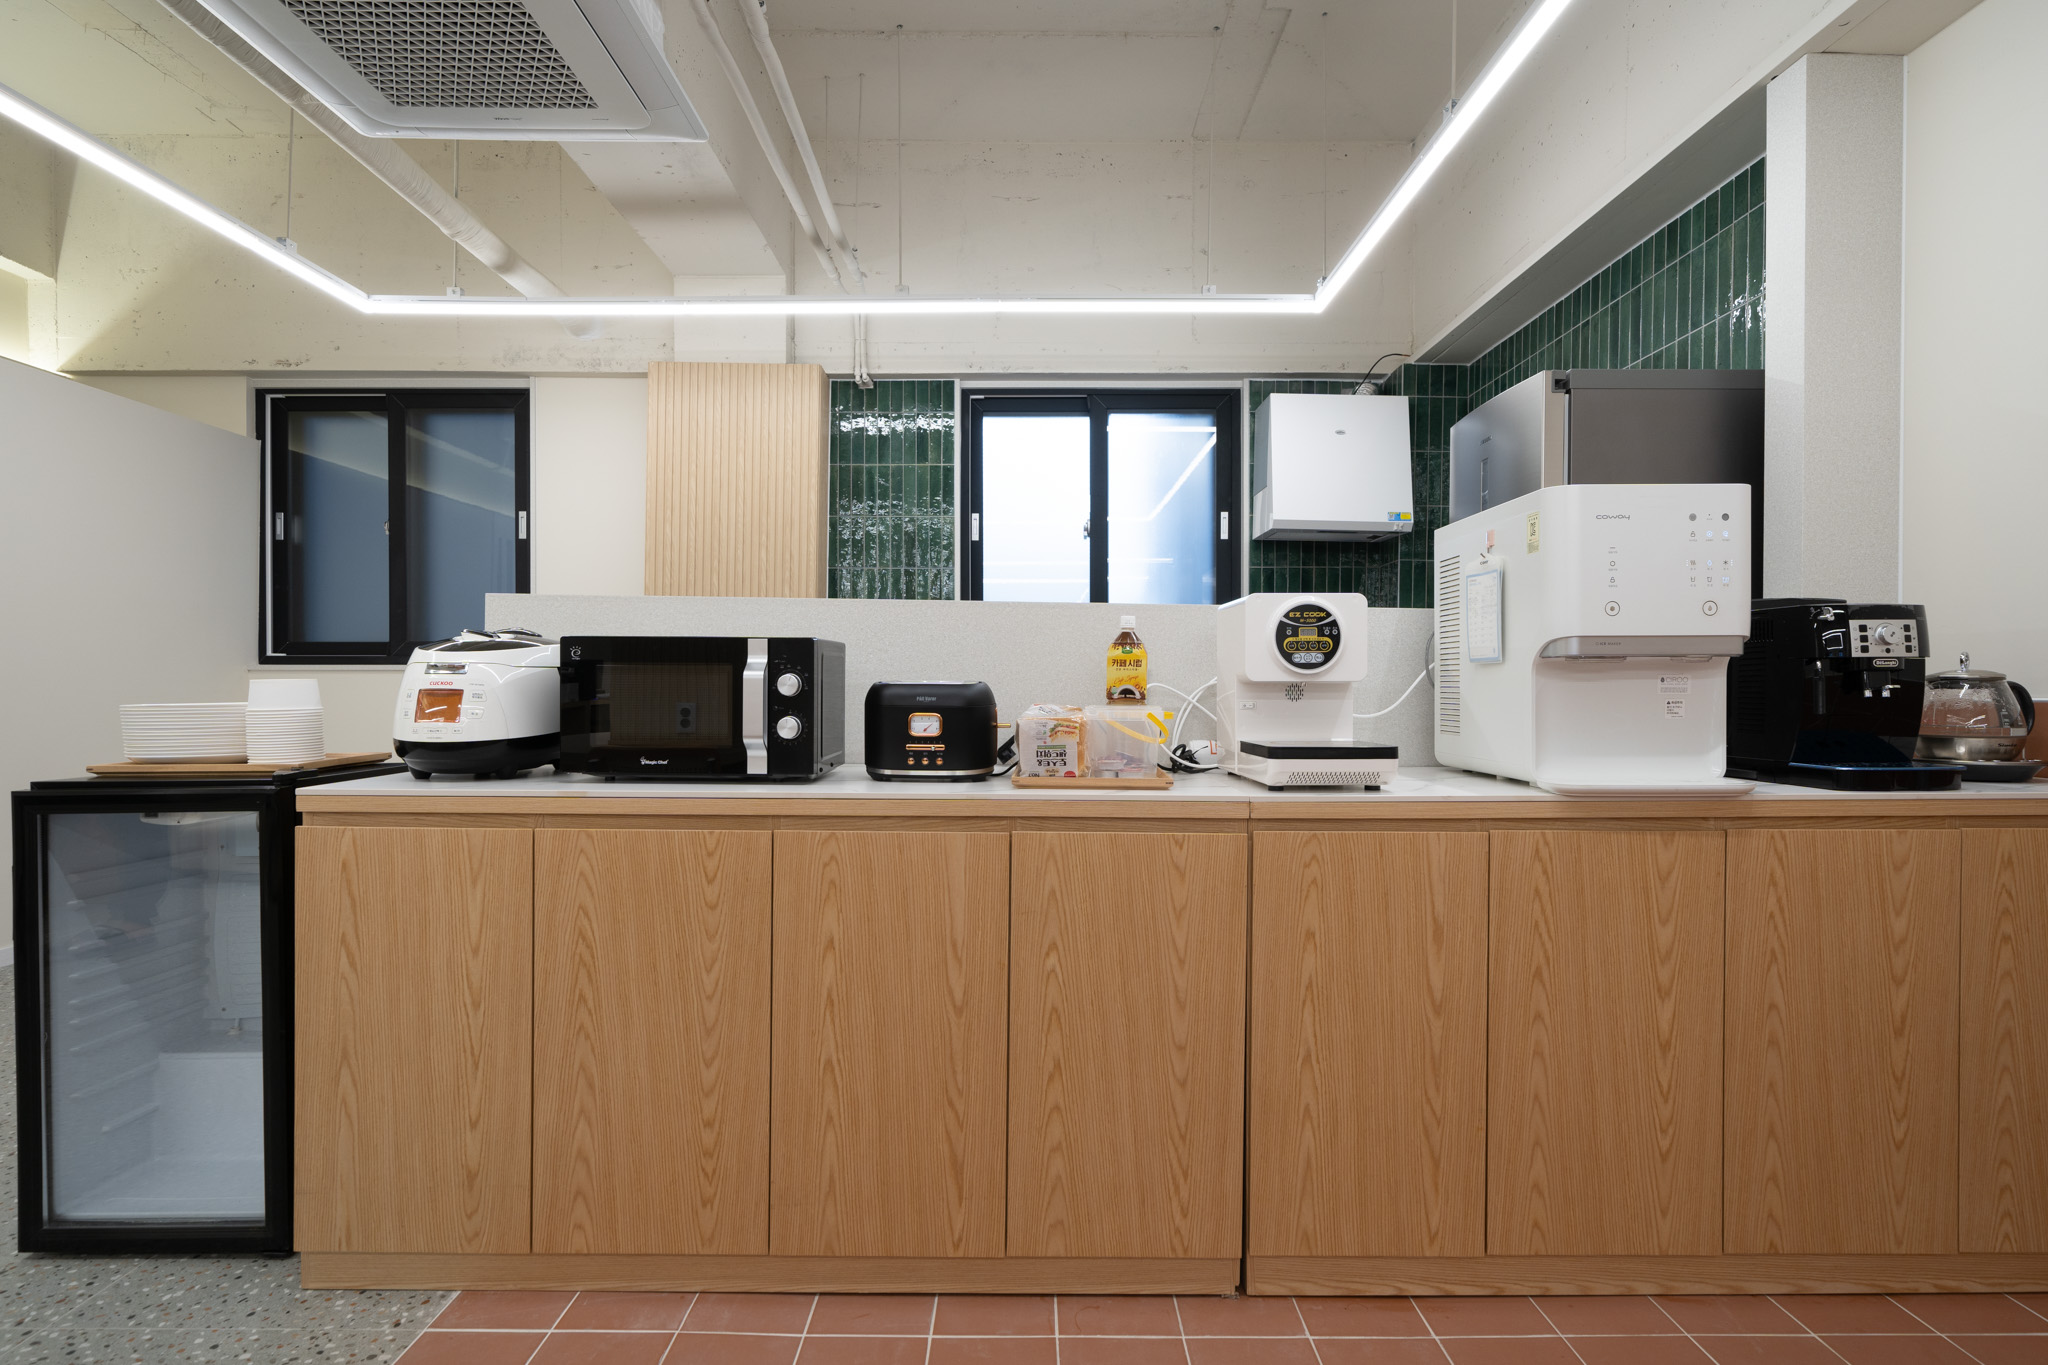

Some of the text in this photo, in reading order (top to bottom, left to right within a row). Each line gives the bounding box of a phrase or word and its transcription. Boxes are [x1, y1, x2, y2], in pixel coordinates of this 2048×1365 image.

[1111, 659, 1142, 667] 카페 시럽
[1036, 749, 1067, 758] 샌드위치
[1036, 758, 1067, 767] 토스트&
